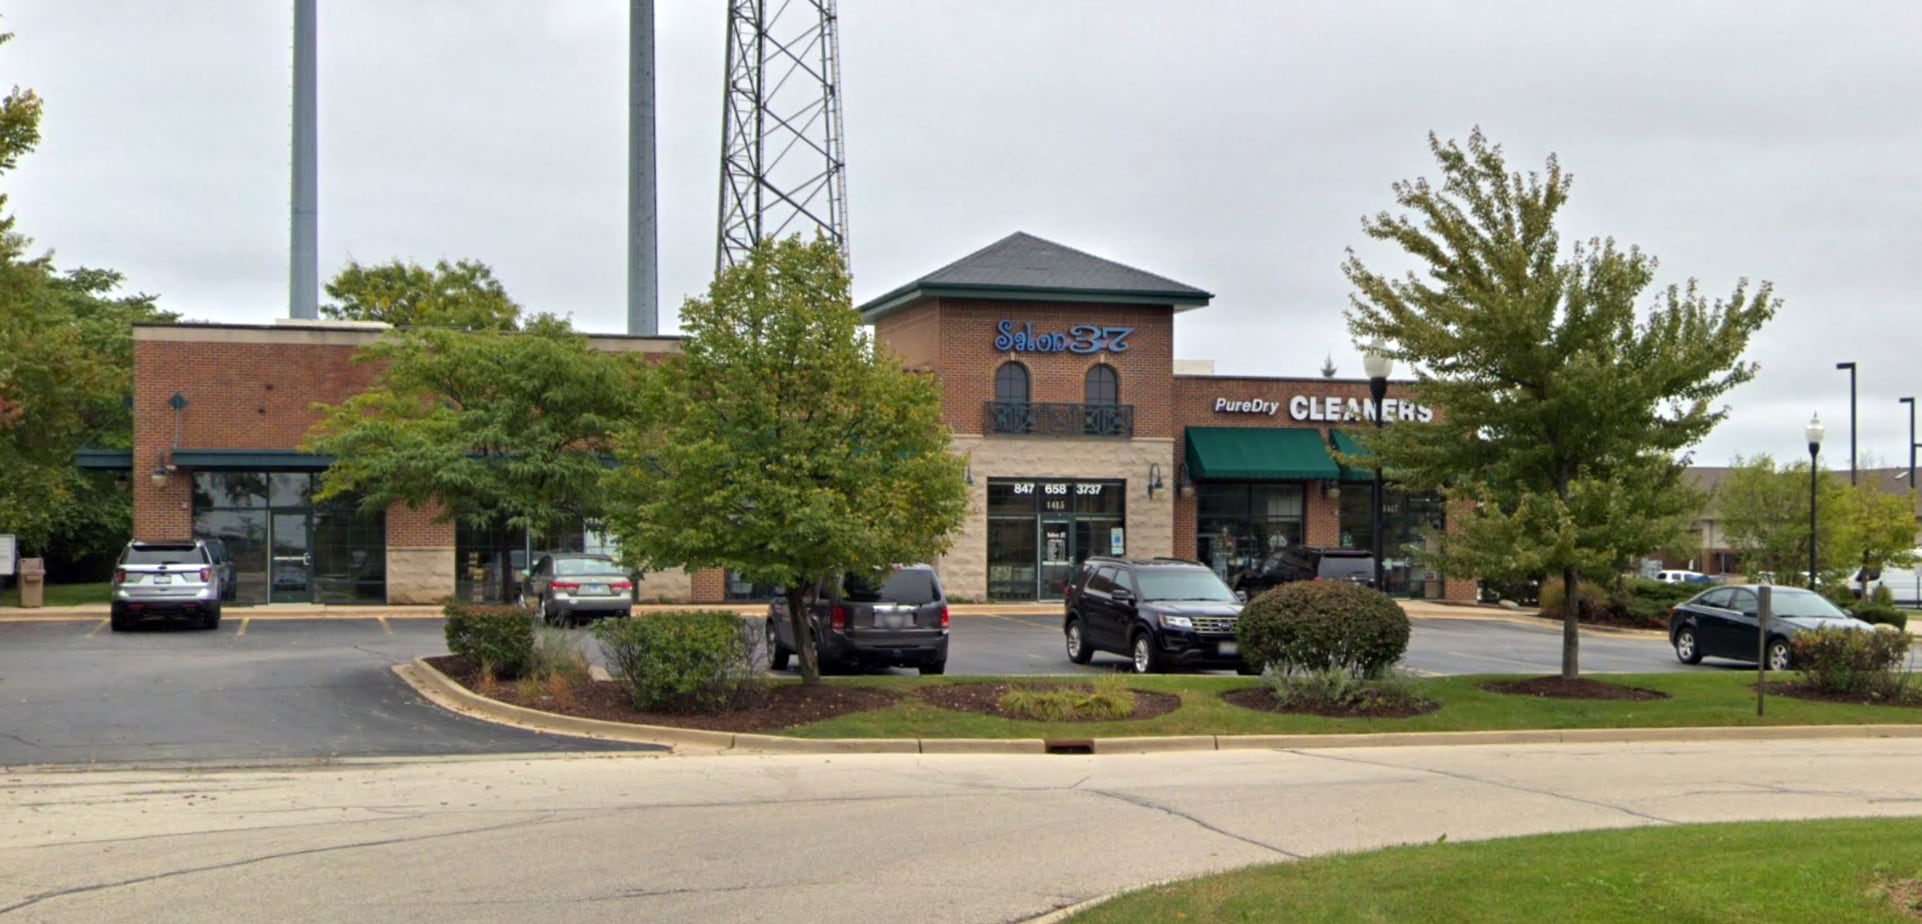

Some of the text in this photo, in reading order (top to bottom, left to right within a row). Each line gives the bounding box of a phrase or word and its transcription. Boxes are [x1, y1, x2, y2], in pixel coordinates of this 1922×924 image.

[994, 319, 1134, 354] Salon 37
[1215, 395, 1433, 423] PureDry CLEANERS
[1013, 483, 1102, 495] 847 658 3737
